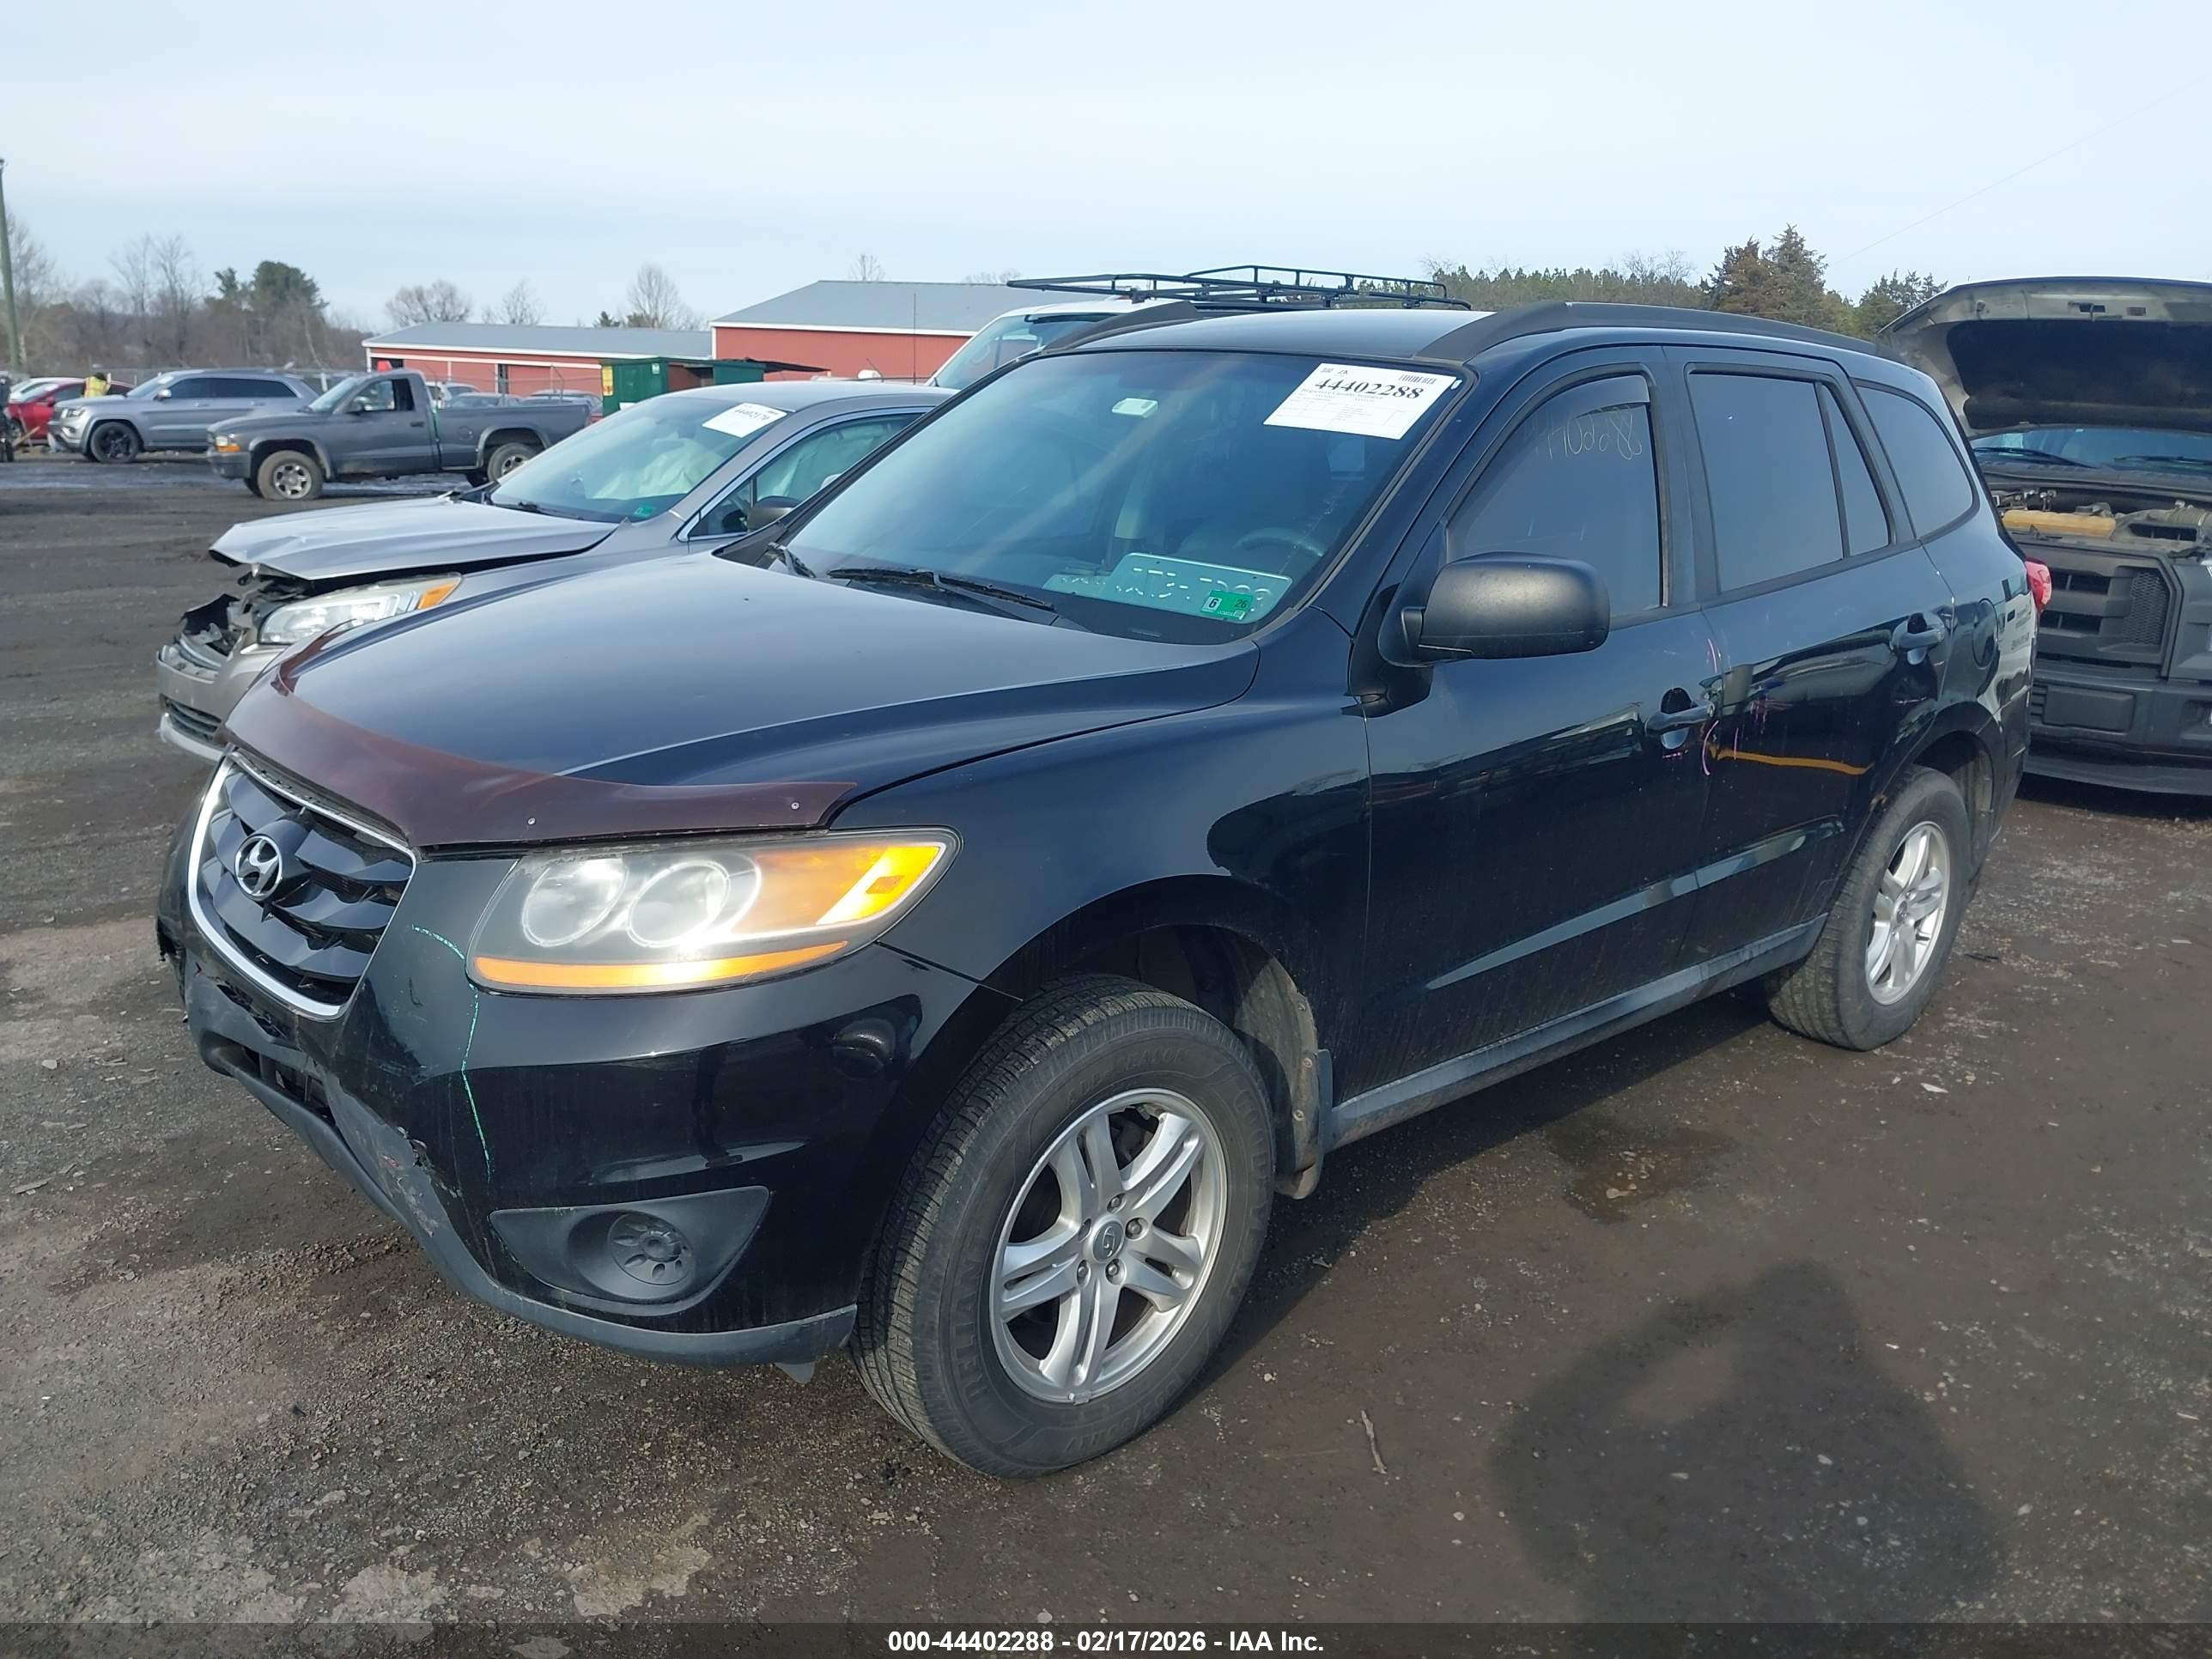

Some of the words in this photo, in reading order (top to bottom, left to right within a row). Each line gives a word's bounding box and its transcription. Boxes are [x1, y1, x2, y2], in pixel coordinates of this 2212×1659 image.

[1315, 378, 1425, 398] 44402288
[1209, 599, 1218, 608] 6
[1235, 599, 1249, 609] 26
